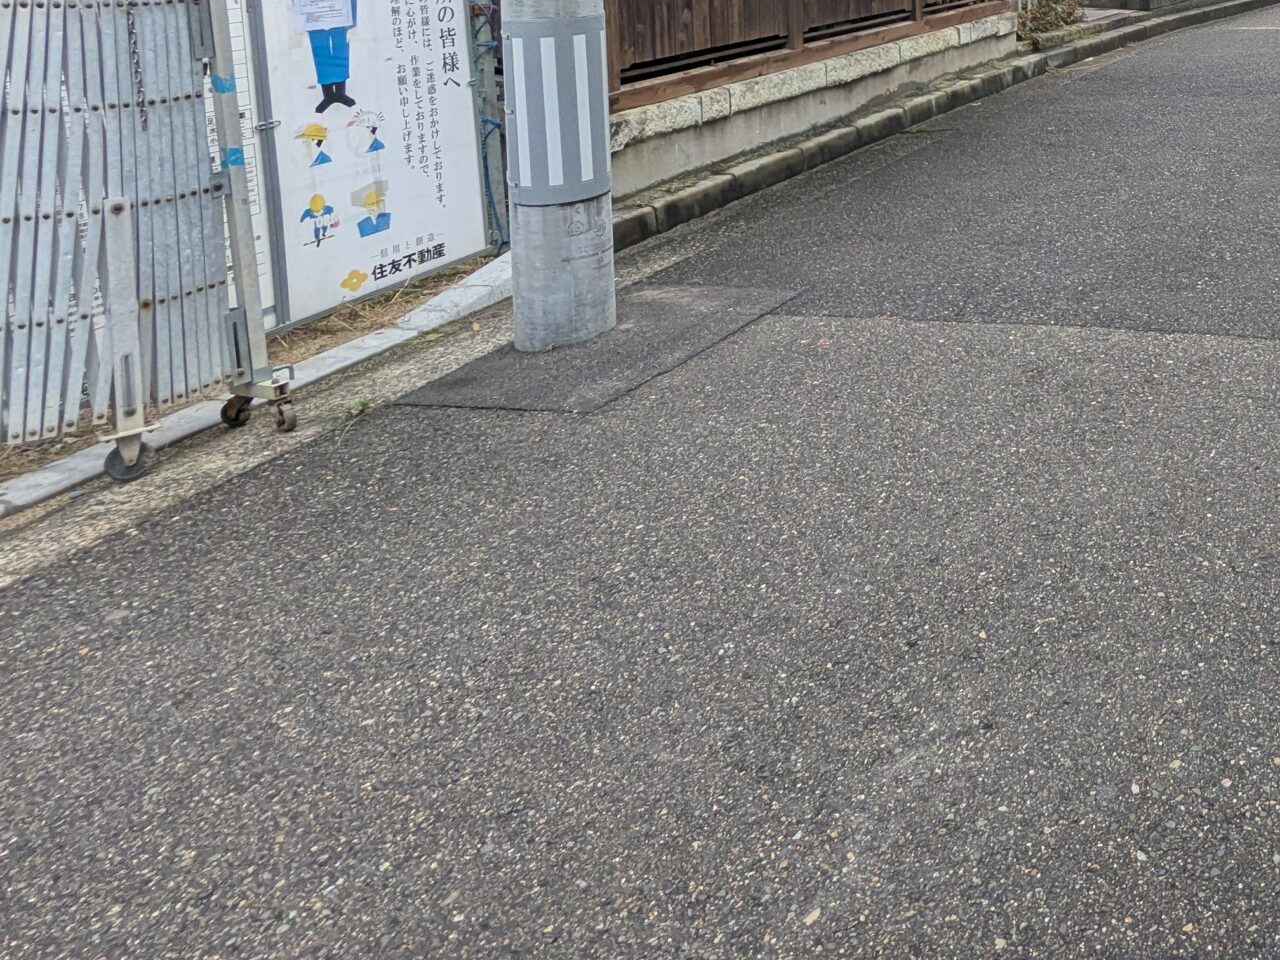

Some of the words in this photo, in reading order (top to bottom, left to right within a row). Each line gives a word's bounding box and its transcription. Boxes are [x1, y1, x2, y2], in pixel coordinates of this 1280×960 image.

[371, 242, 447, 282] 住友不動産
